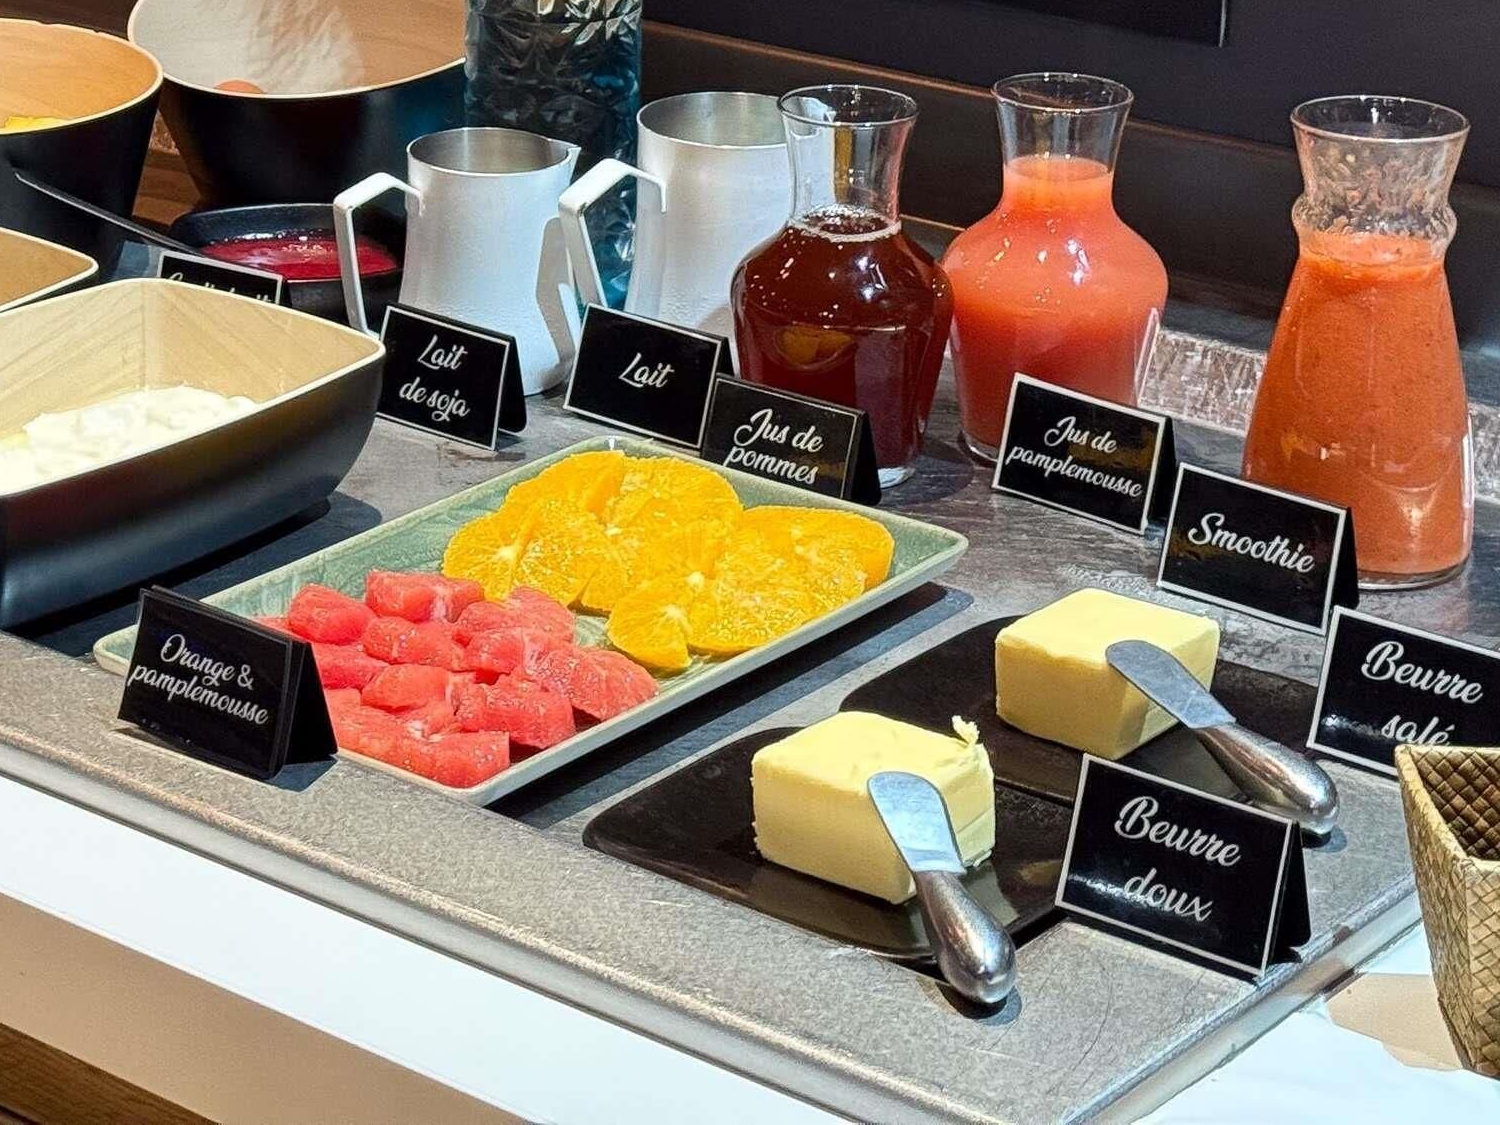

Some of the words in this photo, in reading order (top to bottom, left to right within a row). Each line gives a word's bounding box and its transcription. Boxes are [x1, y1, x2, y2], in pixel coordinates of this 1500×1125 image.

[417, 334, 468, 370] Lait
[618, 352, 675, 388] Lait
[399, 377, 427, 403] de
[426, 389, 471, 422] soja
[733, 408, 787, 447] Jus
[791, 425, 824, 453] de
[1044, 416, 1090, 447] Jus
[1091, 430, 1118, 454] de
[723, 447, 819, 485] pommes
[1005, 445, 1143, 498] pamplemousse
[1187, 512, 1316, 574] Smoothie
[160, 633, 234, 687] Orange
[237, 664, 254, 690] &
[1361, 641, 1484, 704] Beurre
[127, 664, 269, 725] pamplemousse
[1114, 795, 1242, 867] Beurre
[1123, 867, 1214, 922] doux
